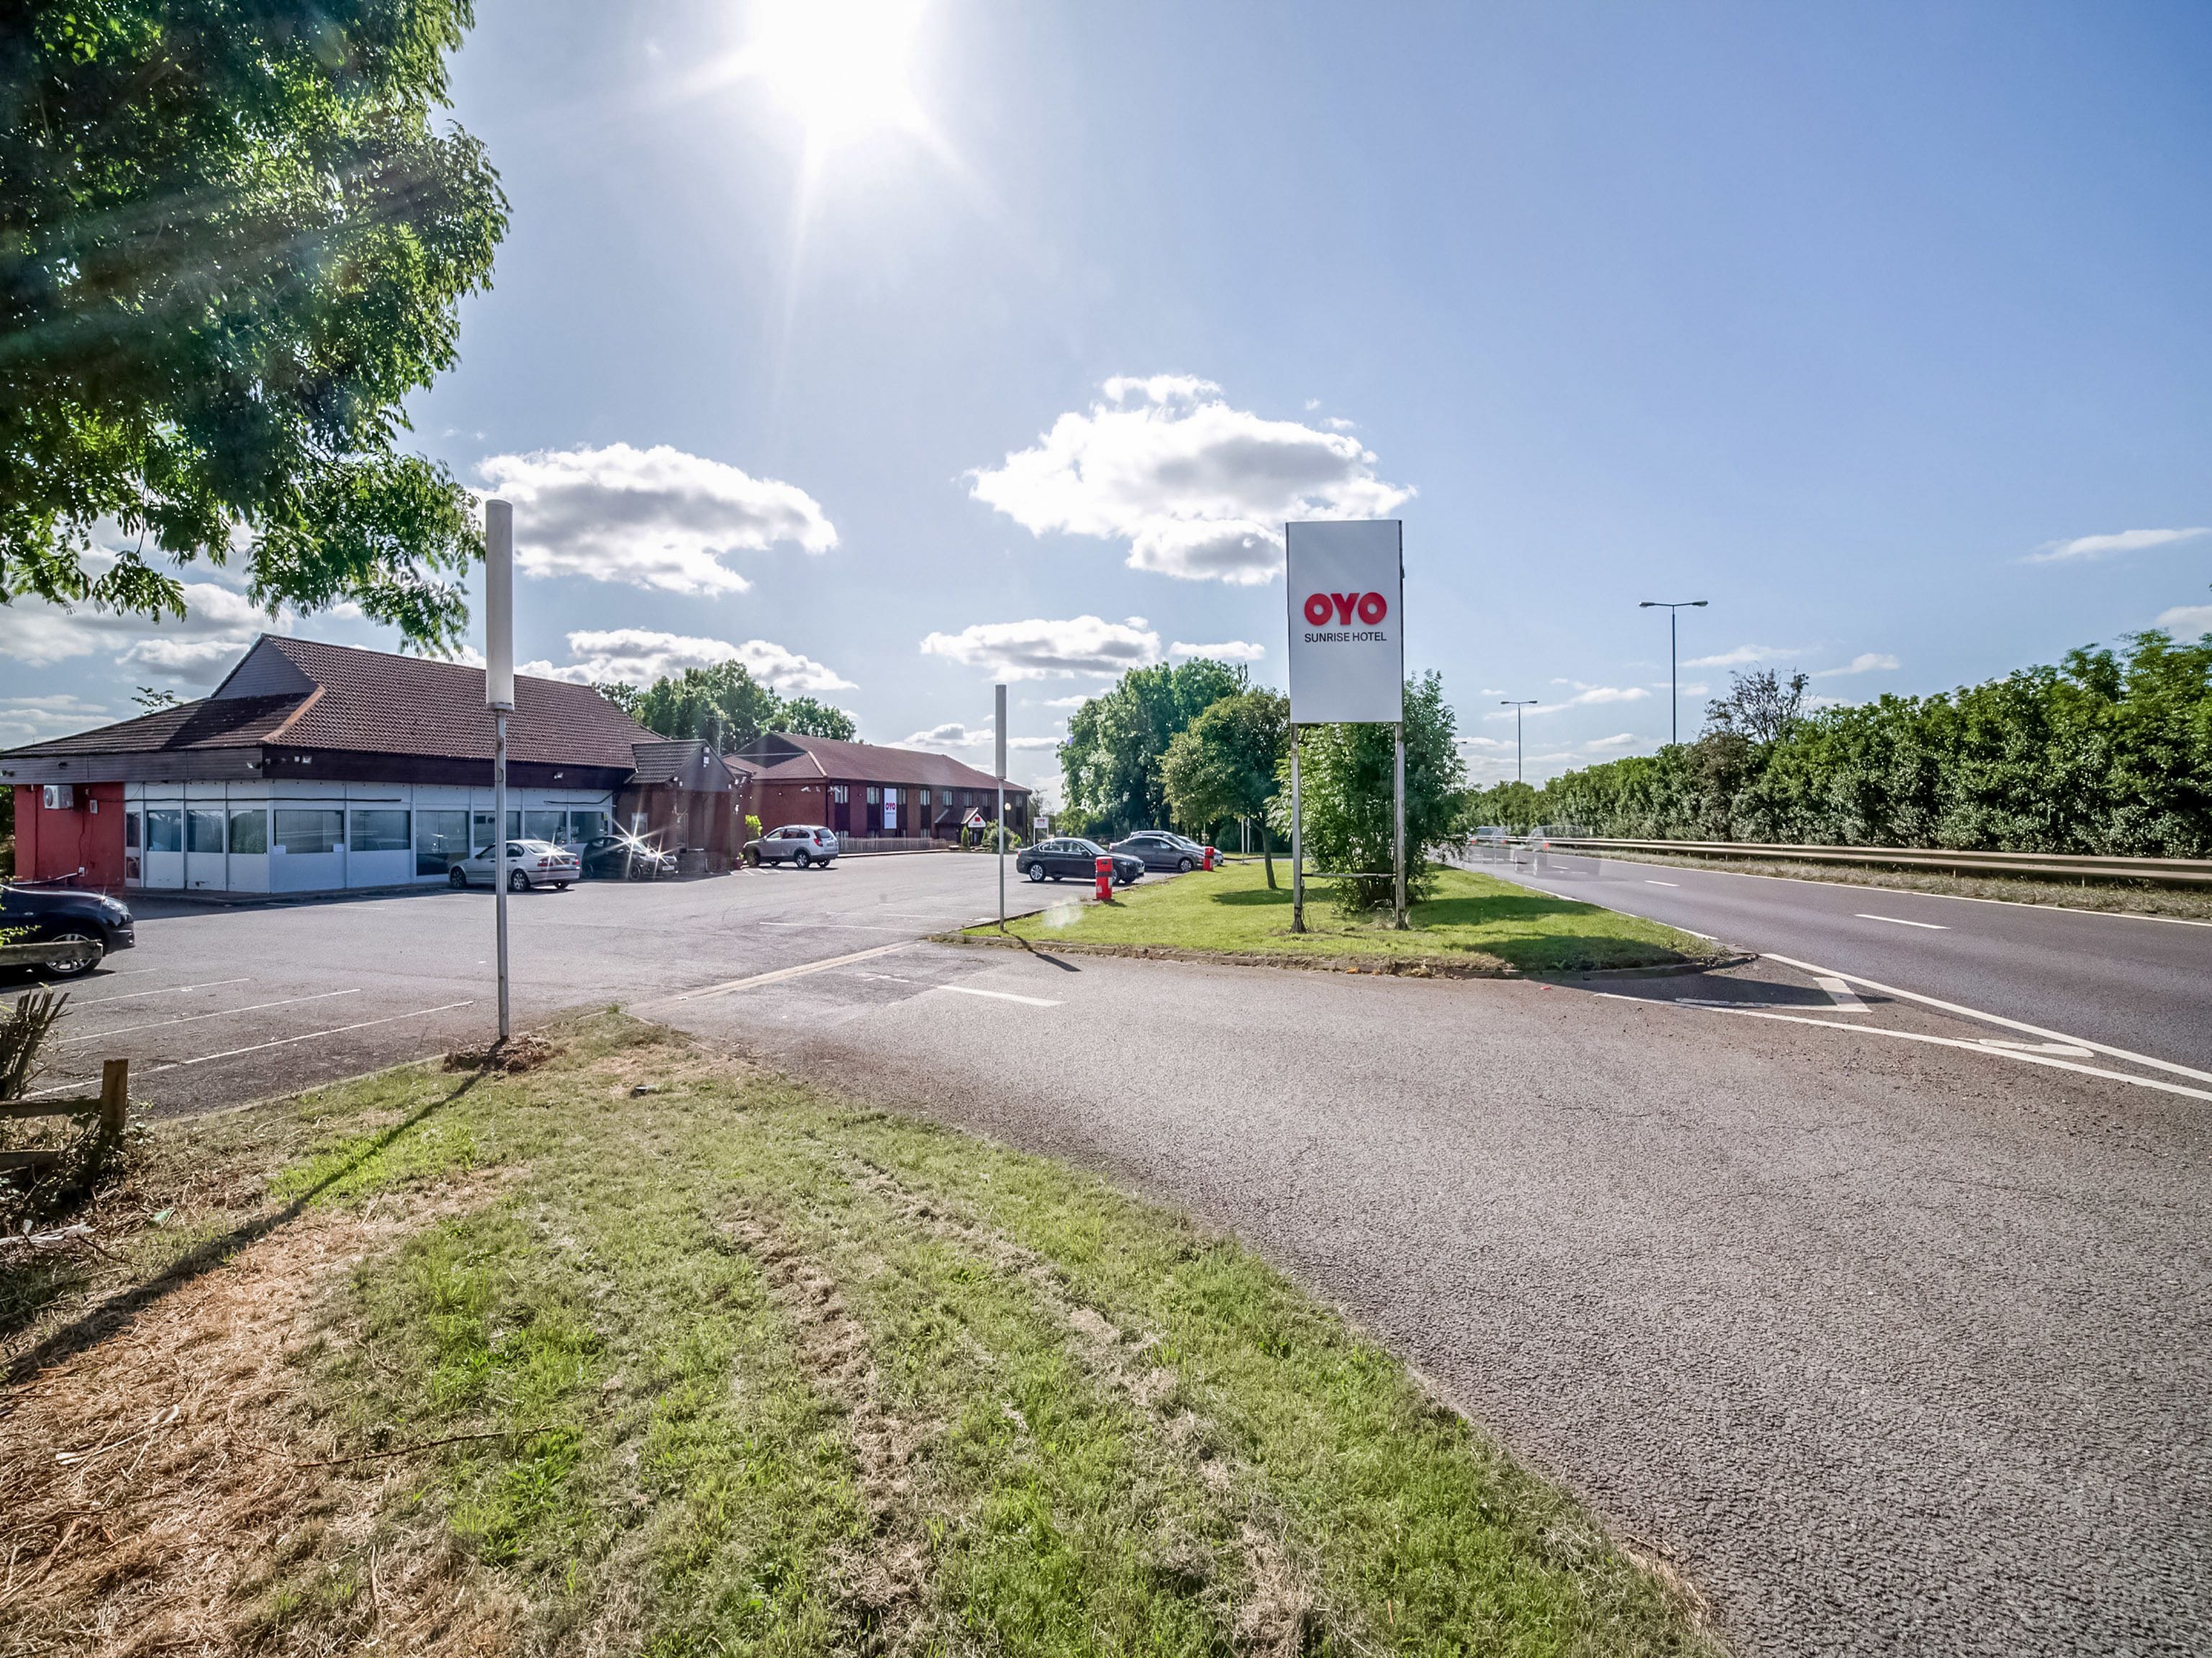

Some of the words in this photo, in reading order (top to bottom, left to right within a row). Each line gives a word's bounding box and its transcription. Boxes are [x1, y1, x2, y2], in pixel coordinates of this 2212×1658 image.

[1304, 592, 1387, 626] OYO
[1304, 633, 1350, 643] SUNRISE
[1352, 632, 1387, 642] HOTEL
